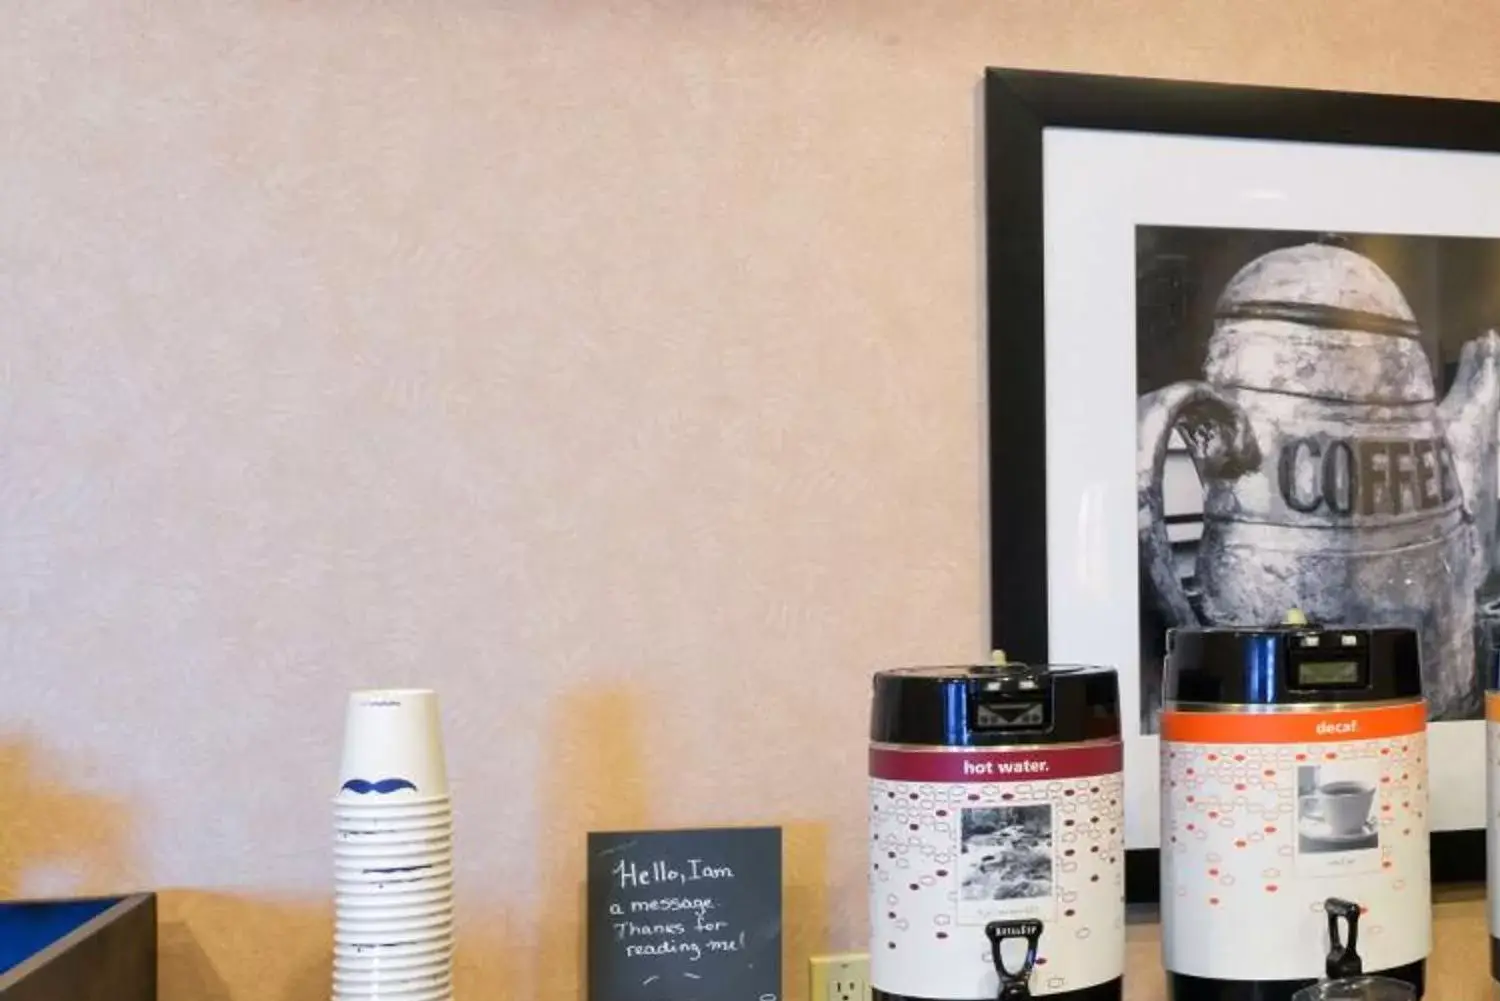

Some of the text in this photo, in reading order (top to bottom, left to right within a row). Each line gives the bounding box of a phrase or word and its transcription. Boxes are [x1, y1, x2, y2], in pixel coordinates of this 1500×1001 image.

[963, 759, 1050, 775] hot water.
[612, 859, 686, 889] Hello,
[609, 902, 625, 915] a
[613, 915, 730, 939] Thanks for
[626, 938, 701, 962] reading
